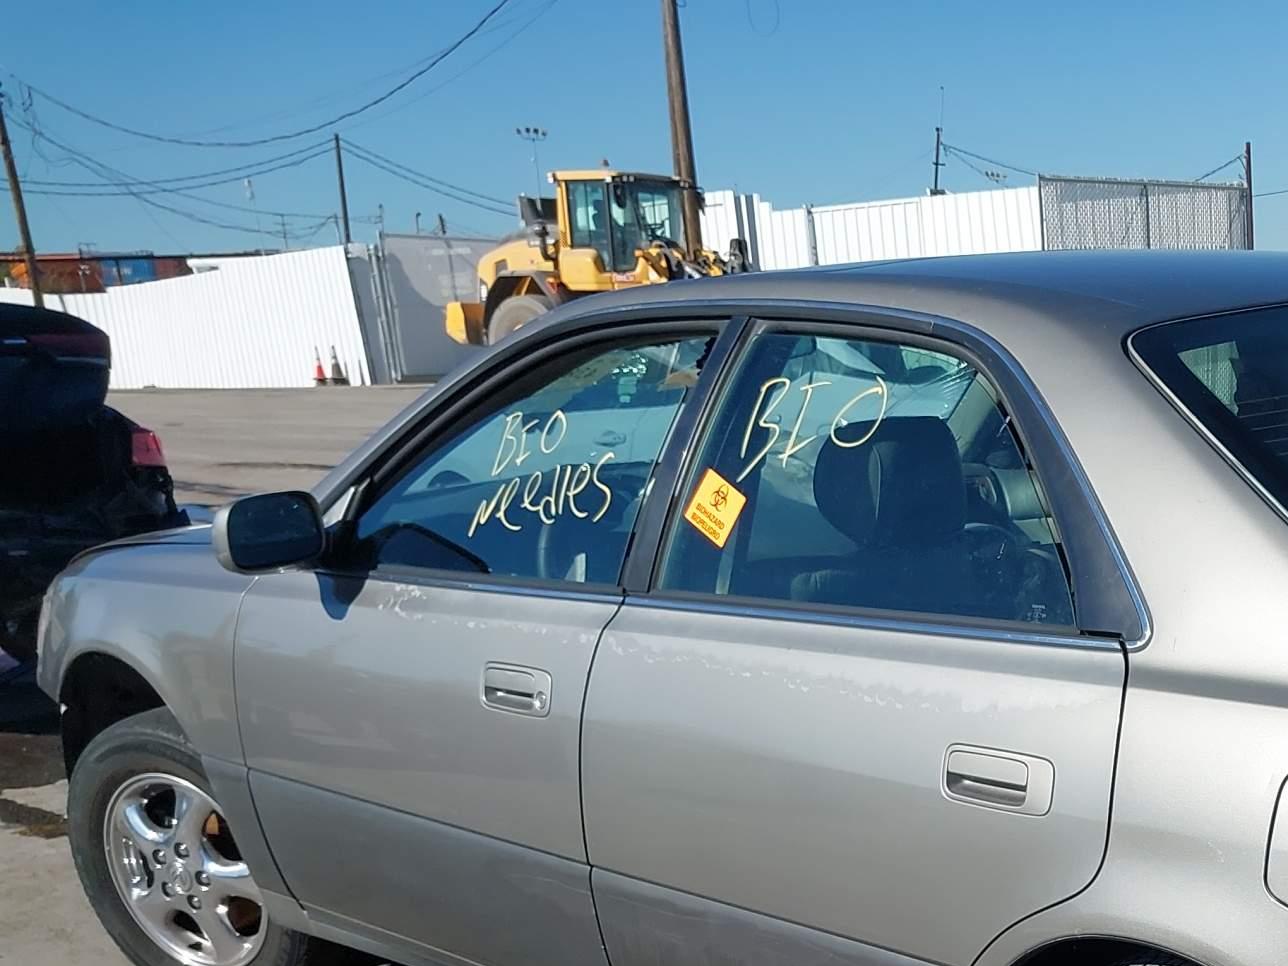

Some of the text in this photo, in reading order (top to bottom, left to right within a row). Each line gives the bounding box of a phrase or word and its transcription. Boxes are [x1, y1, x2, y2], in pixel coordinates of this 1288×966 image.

[491, 409, 568, 477] BIO
[736, 375, 888, 484] BIO
[695, 502, 725, 530] BIOHAZARD
